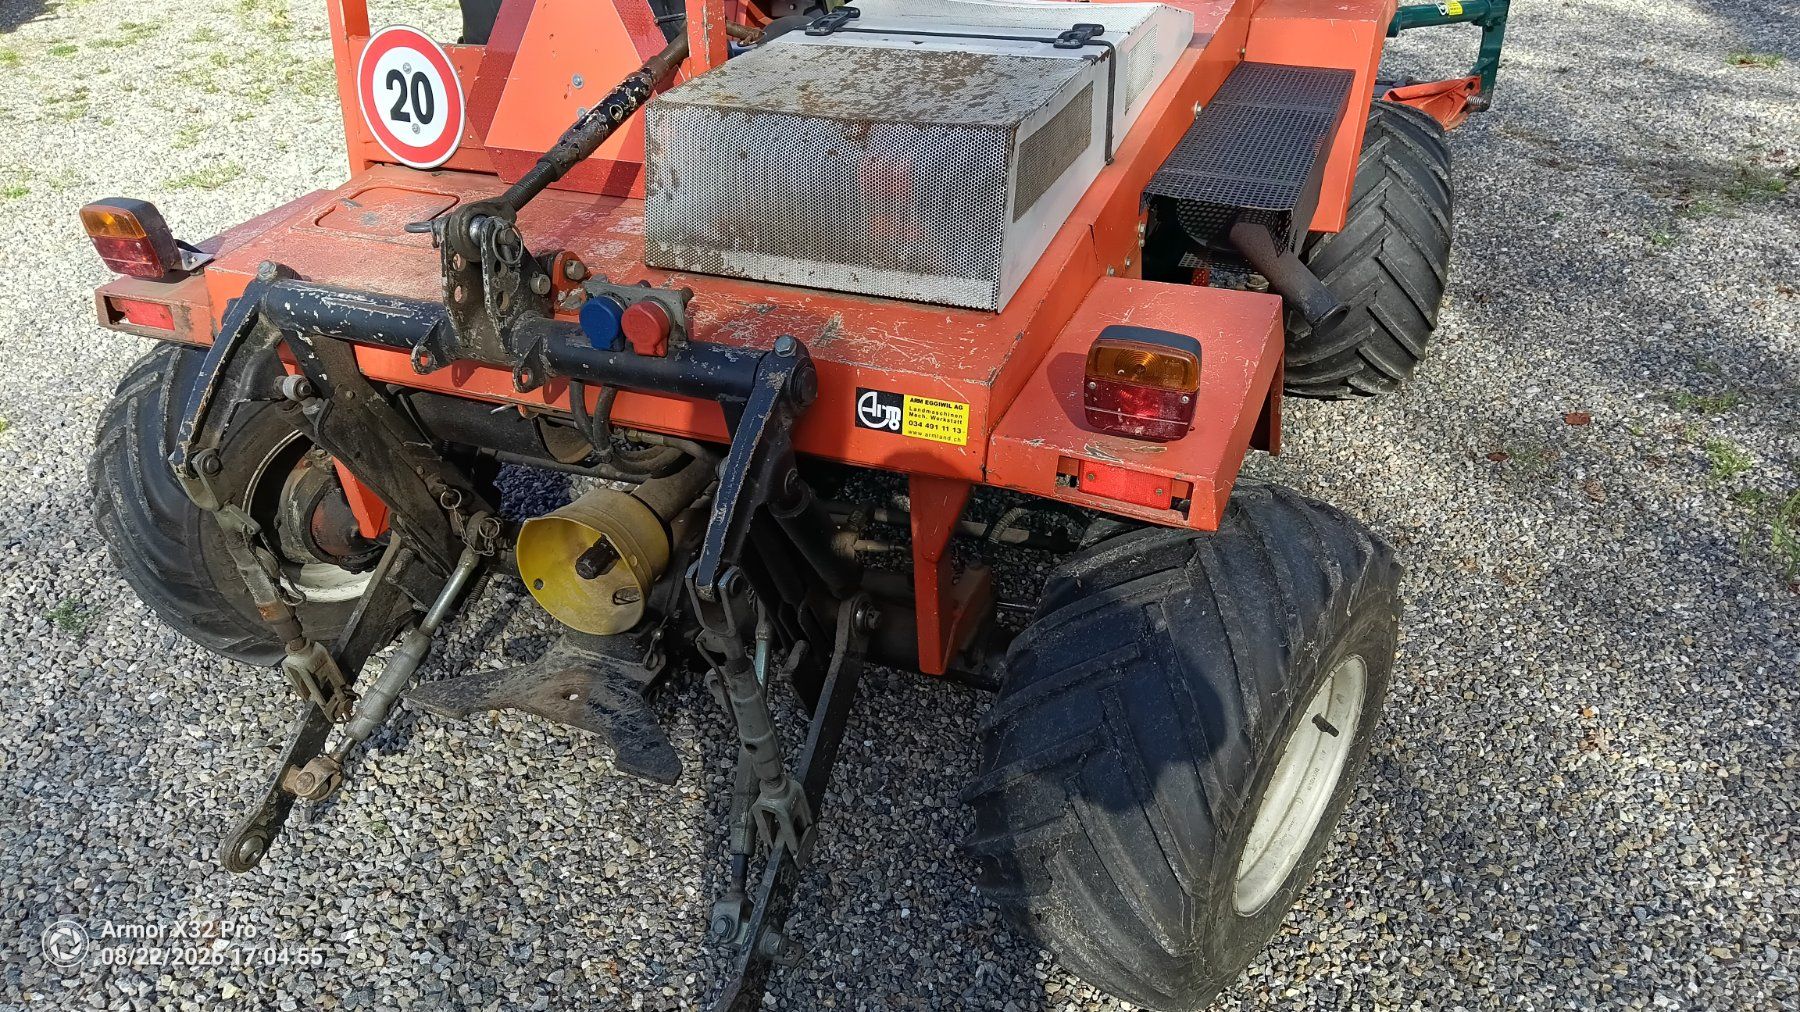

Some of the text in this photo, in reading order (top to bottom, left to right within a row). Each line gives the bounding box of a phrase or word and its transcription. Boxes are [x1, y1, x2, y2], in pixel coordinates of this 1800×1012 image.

[386, 69, 434, 125] 20
[925, 400, 953, 409] EGGIWIL
[909, 406, 963, 419] Landmaschinen
[909, 412, 963, 425] Mech. Werkstatt
[908, 420, 923, 428] 034
